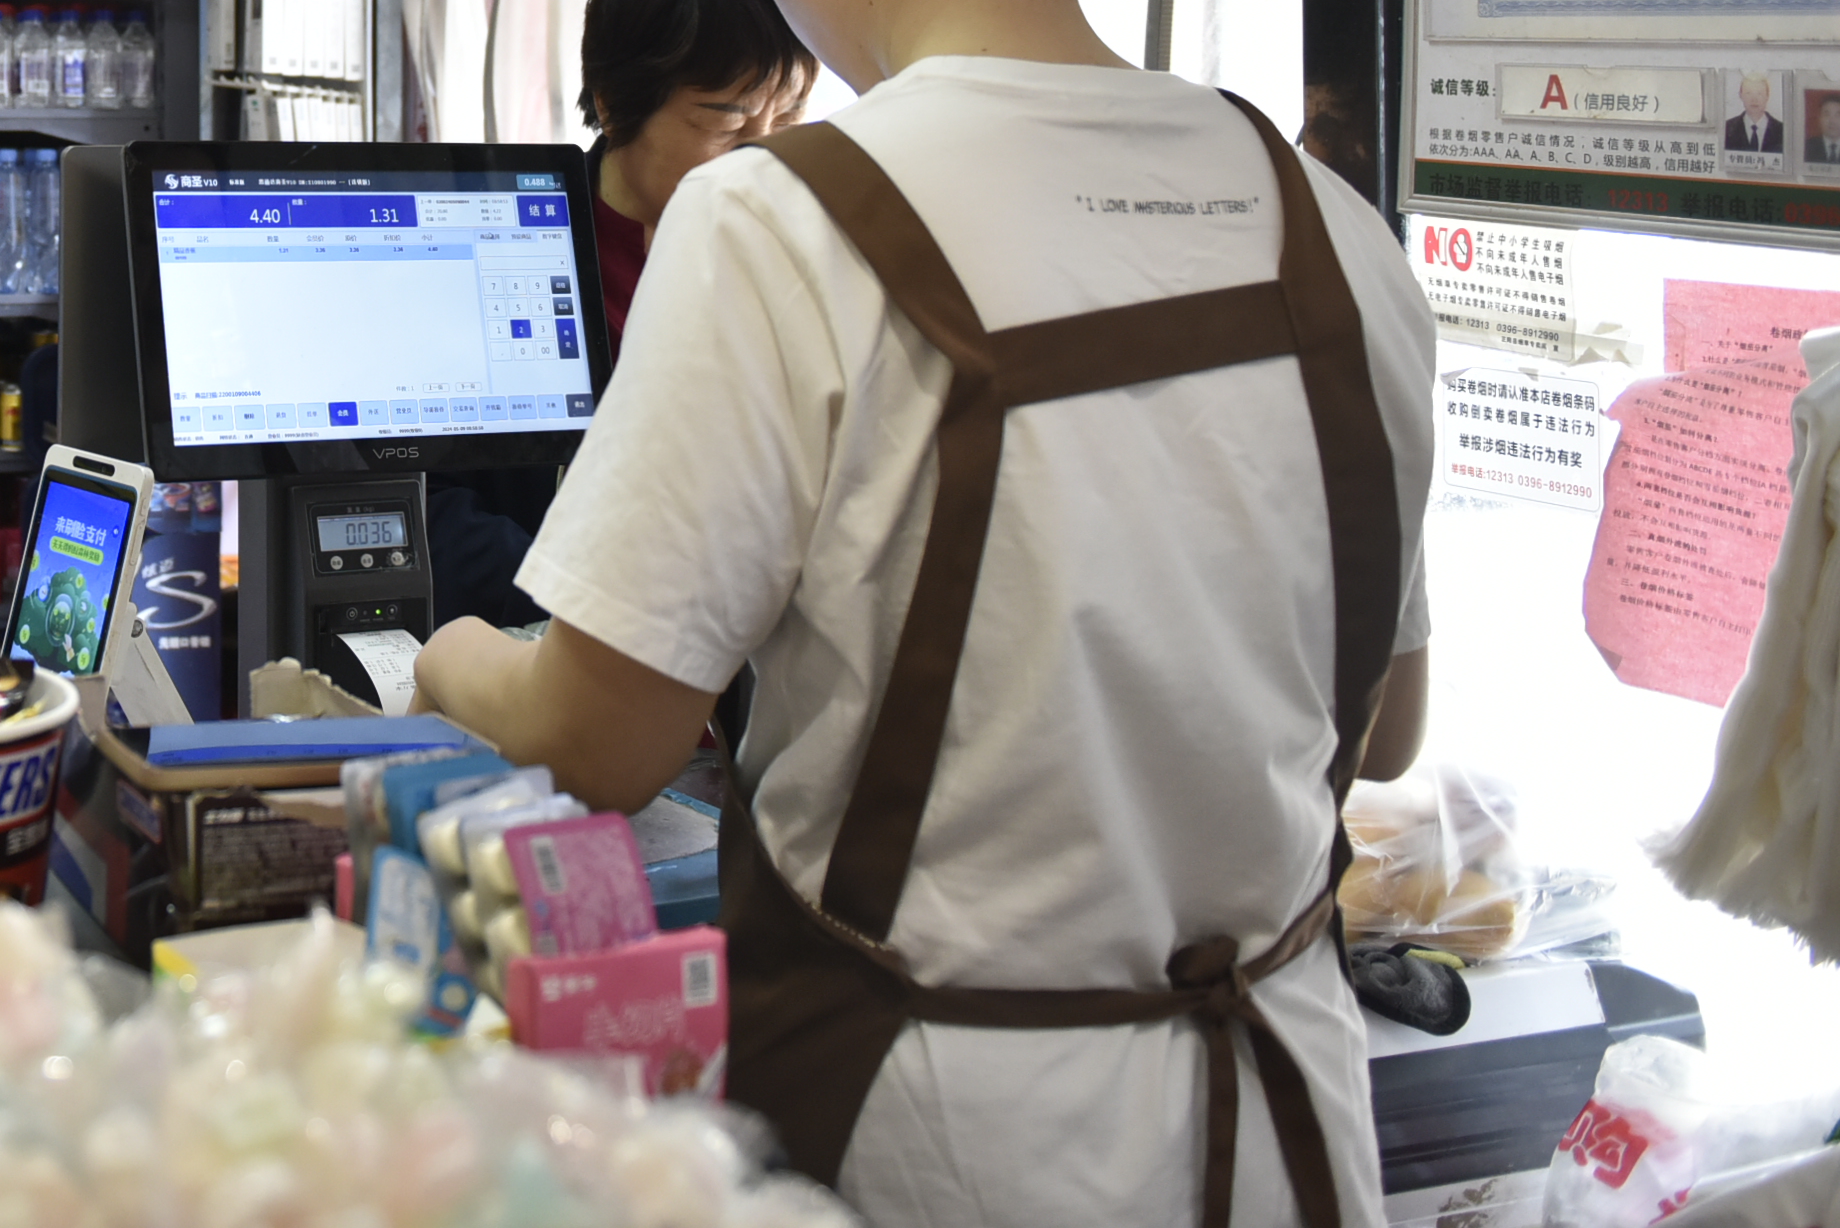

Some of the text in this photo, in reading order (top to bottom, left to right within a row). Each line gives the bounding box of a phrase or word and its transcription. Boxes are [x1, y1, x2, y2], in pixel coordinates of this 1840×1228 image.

[1540, 74, 1568, 112] A
[524, 178, 546, 187] 0.488
[528, 204, 557, 217] 结算
[1607, 189, 1669, 210] 12313
[249, 208, 281, 224] 4.40
[369, 208, 400, 223] 1.31
[1476, 230, 1565, 254] 禁止中小学生吸烟
[1475, 246, 1563, 270] 不向未成年人售烟
[1476, 262, 1565, 286] 不向未成年人售电子烟
[1466, 318, 1490, 330] 12313
[1496, 323, 1560, 342] 0396-8912990
[1447, 400, 1595, 438] 收购倒卖卷烟属于违法行为
[372, 446, 420, 459] VPOS
[1459, 433, 1583, 469] 举报涉烟违法行为有奖
[1517, 474, 1593, 499] 0396-8912990
[346, 522, 392, 546] 0.036
